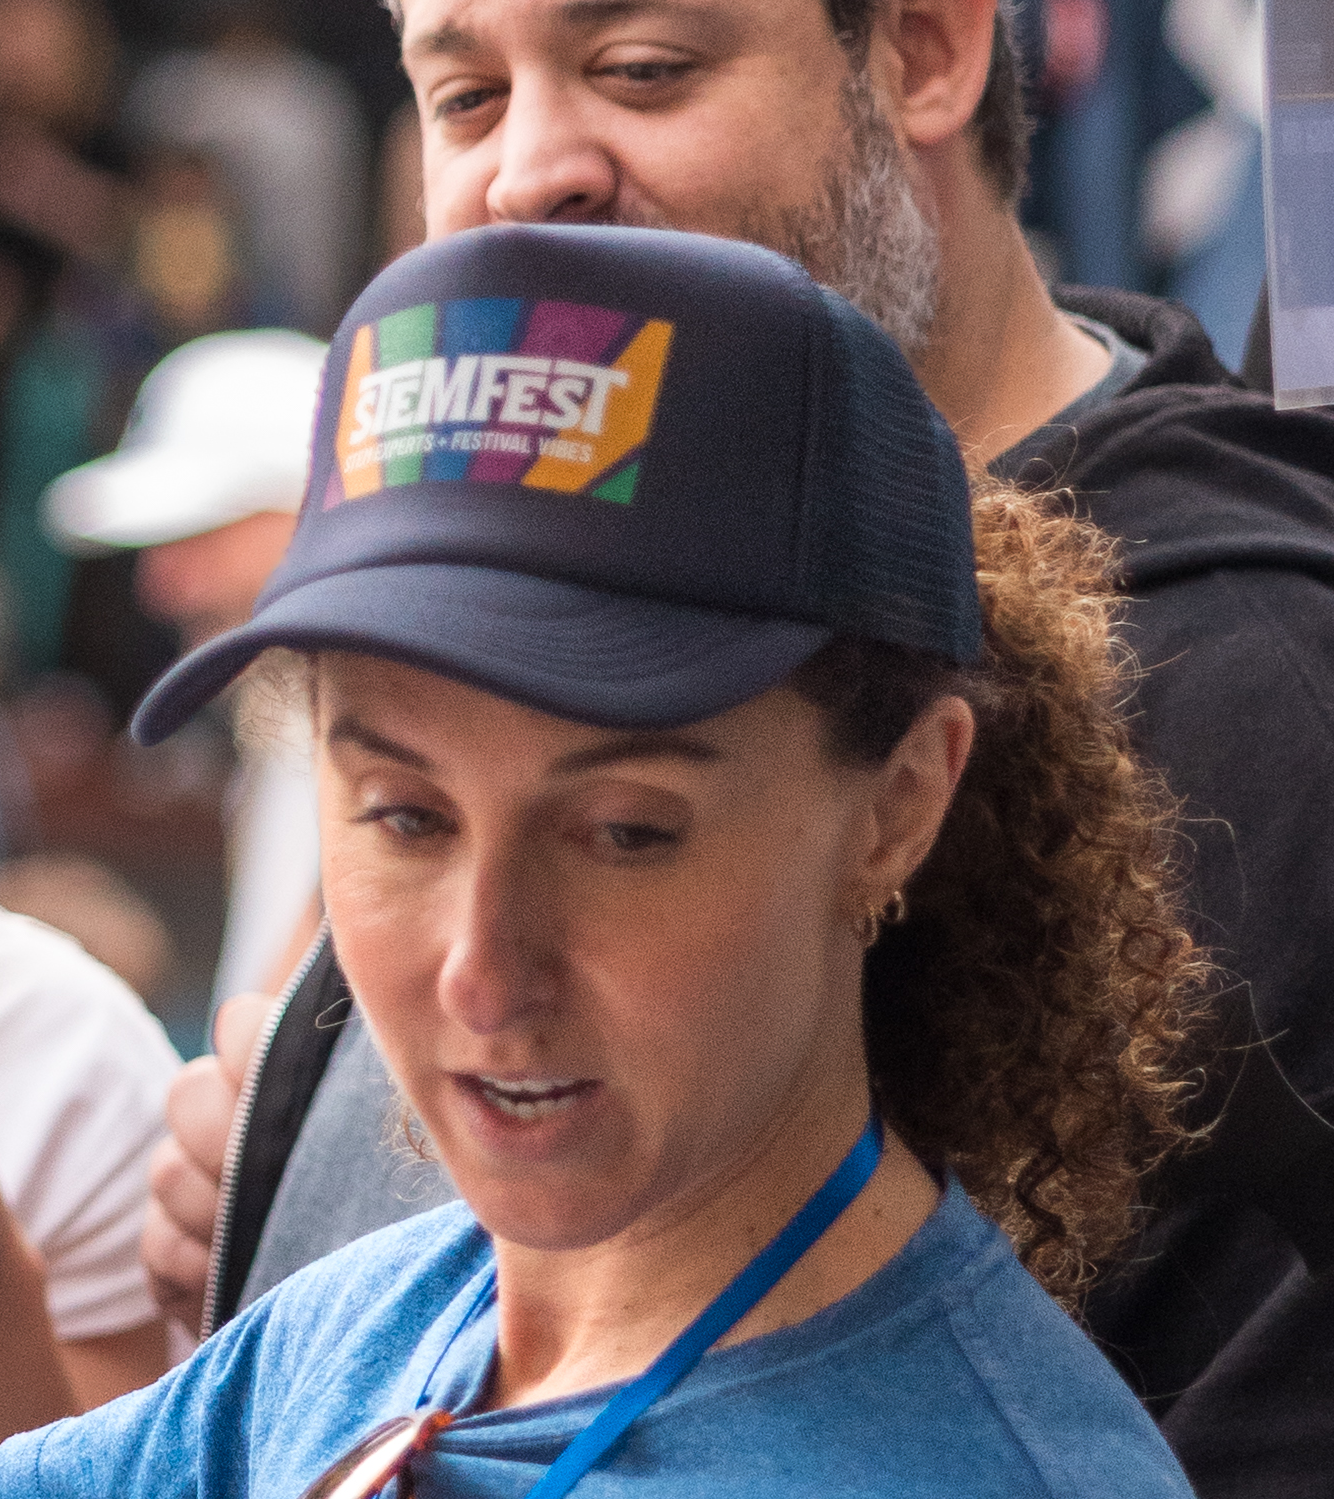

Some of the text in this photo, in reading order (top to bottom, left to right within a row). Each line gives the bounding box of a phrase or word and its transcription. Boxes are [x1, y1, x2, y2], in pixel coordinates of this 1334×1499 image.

[348, 353, 630, 446] STEMFEST
[374, 432, 435, 462] EXPERTS
[450, 430, 532, 454] FESTIVAL
[537, 437, 595, 464] VIBES
